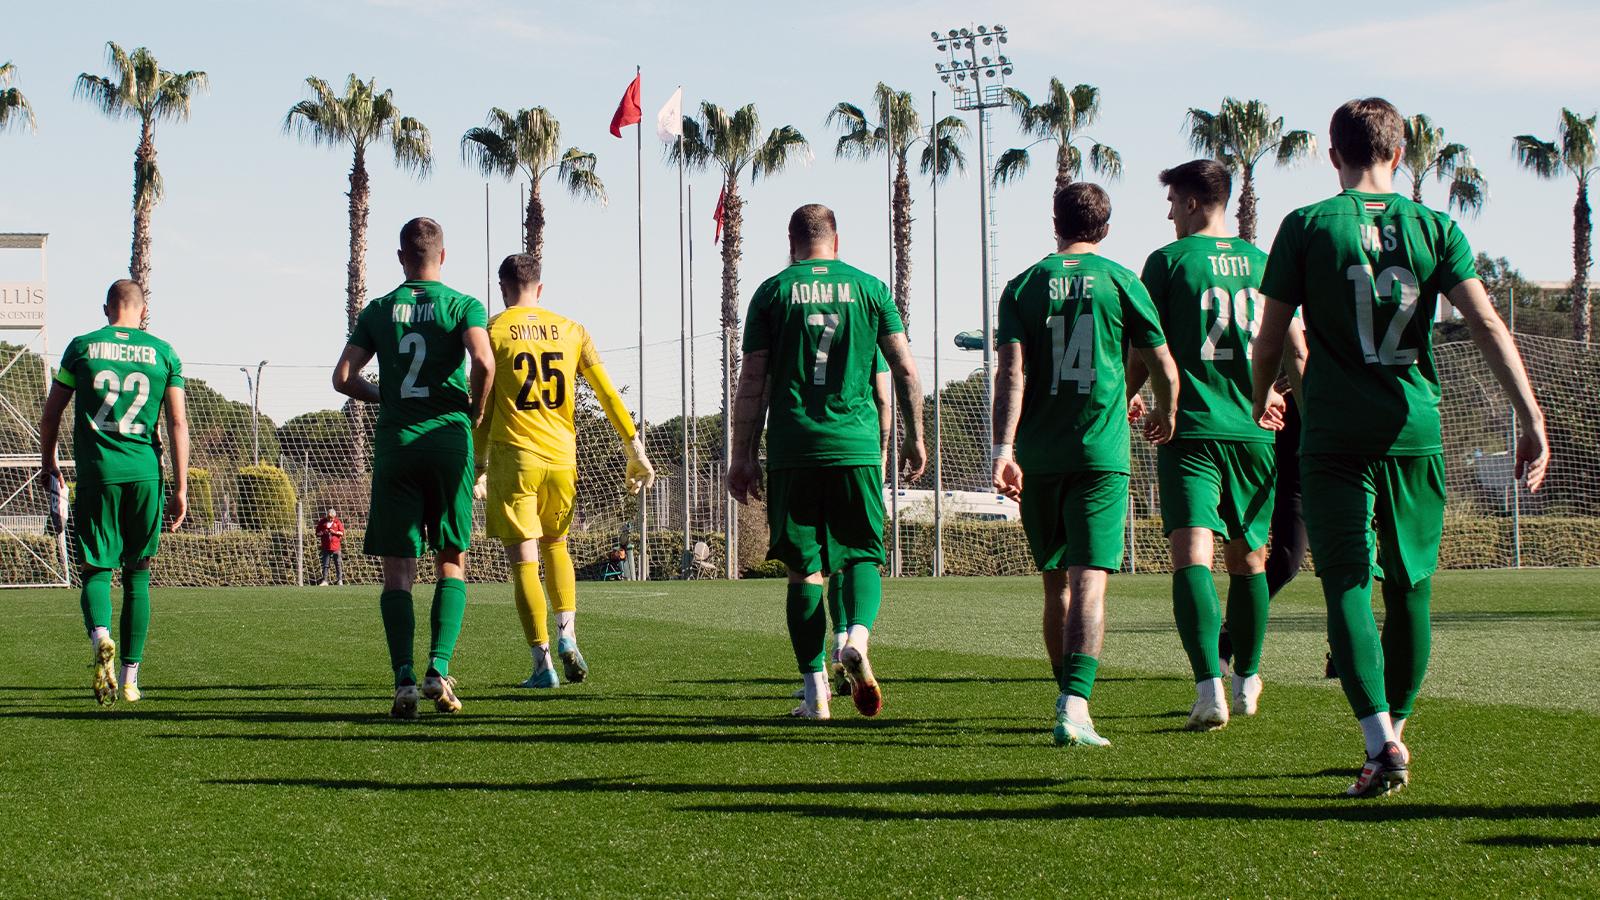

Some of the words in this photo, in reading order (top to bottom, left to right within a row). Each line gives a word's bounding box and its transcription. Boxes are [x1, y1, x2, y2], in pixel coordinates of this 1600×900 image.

[1360, 224, 1398, 252] VAS
[1208, 253, 1250, 277] TÓTH
[791, 281, 834, 305] ÁDÁM
[837, 283, 855, 303] M.
[1048, 275, 1094, 300] SILYE
[7, 311, 44, 320] CENTER
[509, 324, 548, 341] SIMON
[1201, 287, 1266, 361] 29
[1347, 263, 1420, 366] 12
[88, 342, 157, 365] WINDECKER
[399, 332, 430, 399] 2
[807, 313, 839, 385] 7
[1046, 314, 1097, 395] 14
[92, 369, 151, 434] 22
[513, 352, 566, 411] 25
